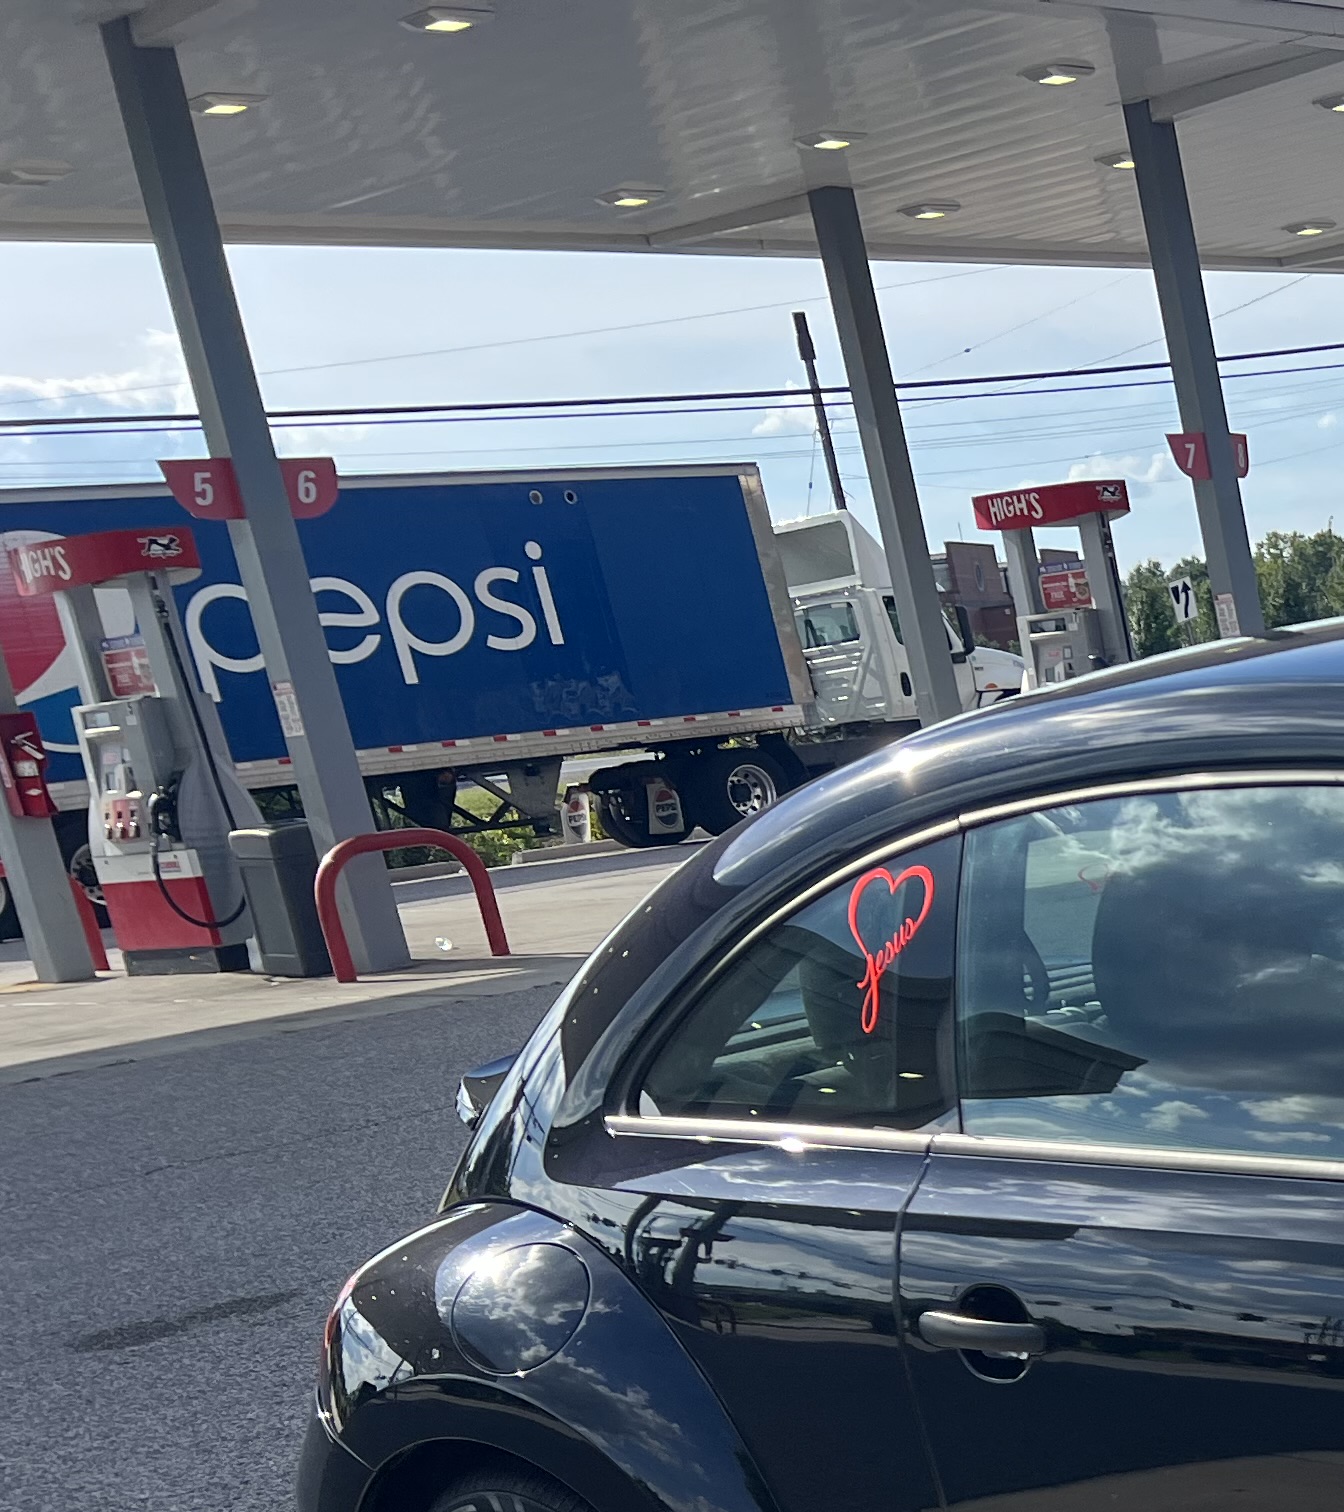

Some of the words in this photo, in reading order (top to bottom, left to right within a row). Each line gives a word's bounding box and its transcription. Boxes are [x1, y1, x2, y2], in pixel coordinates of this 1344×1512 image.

[1184, 443, 1196, 469] 7
[1237, 443, 1245, 468] 8
[194, 471, 214, 506] 5
[297, 470, 317, 504] 6
[987, 492, 1043, 526] HIGH'S
[185, 541, 564, 702] pepsi
